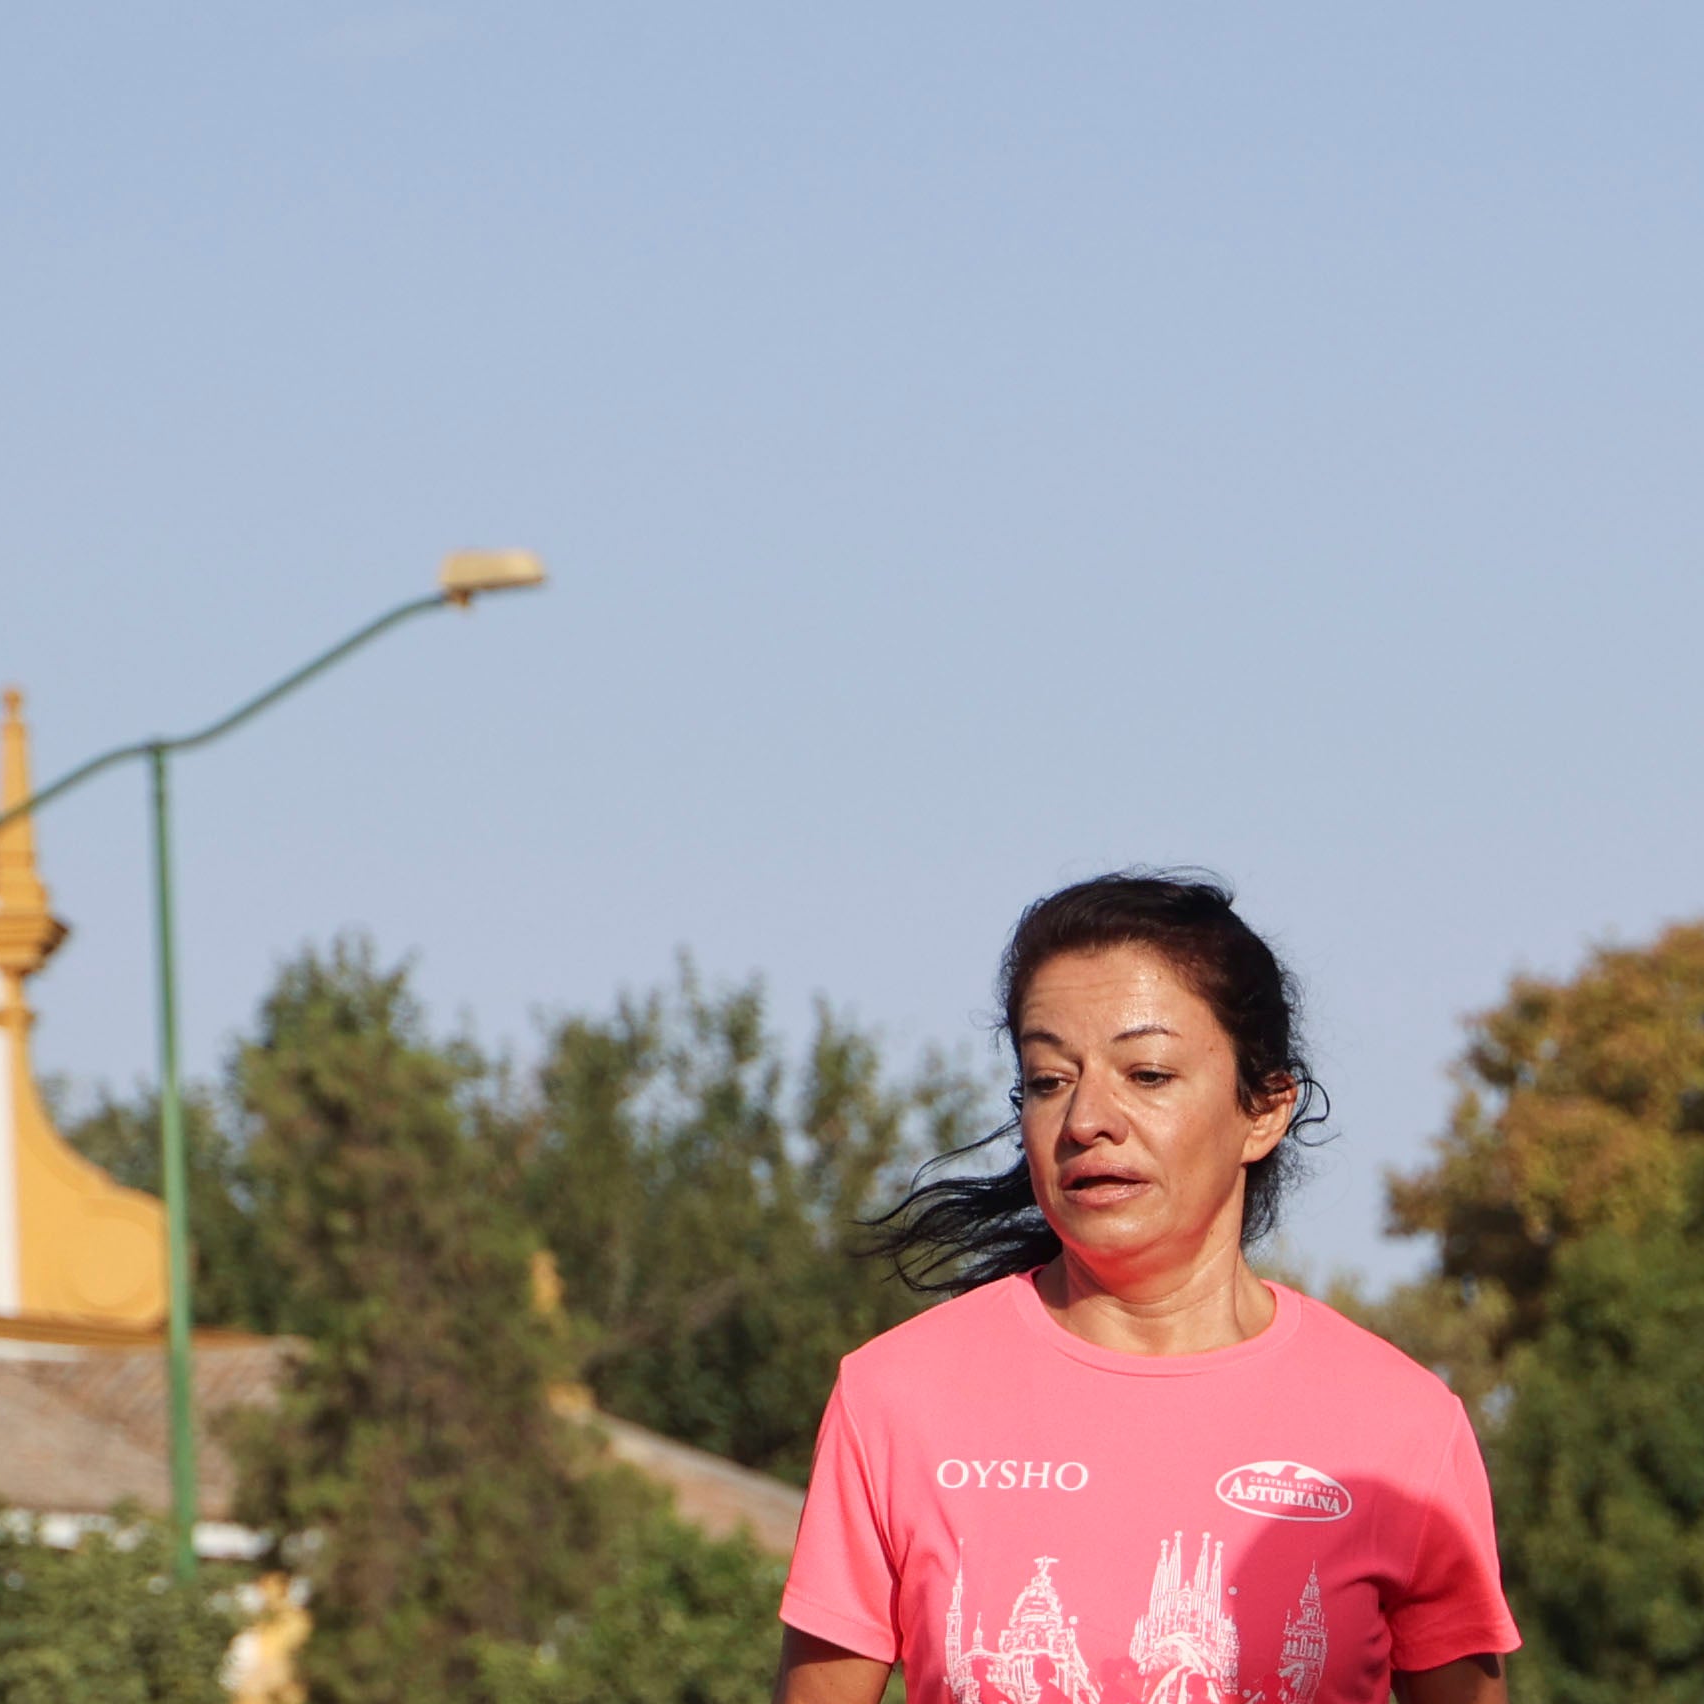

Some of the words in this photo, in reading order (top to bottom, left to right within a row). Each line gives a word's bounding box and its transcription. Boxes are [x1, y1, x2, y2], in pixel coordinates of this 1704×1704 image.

[936, 1458, 1089, 1492] OYSHO
[1248, 1476, 1293, 1488] CENTRAL
[1296, 1482, 1340, 1497] LECHERA
[1226, 1475, 1342, 1514] ASTURIANA
